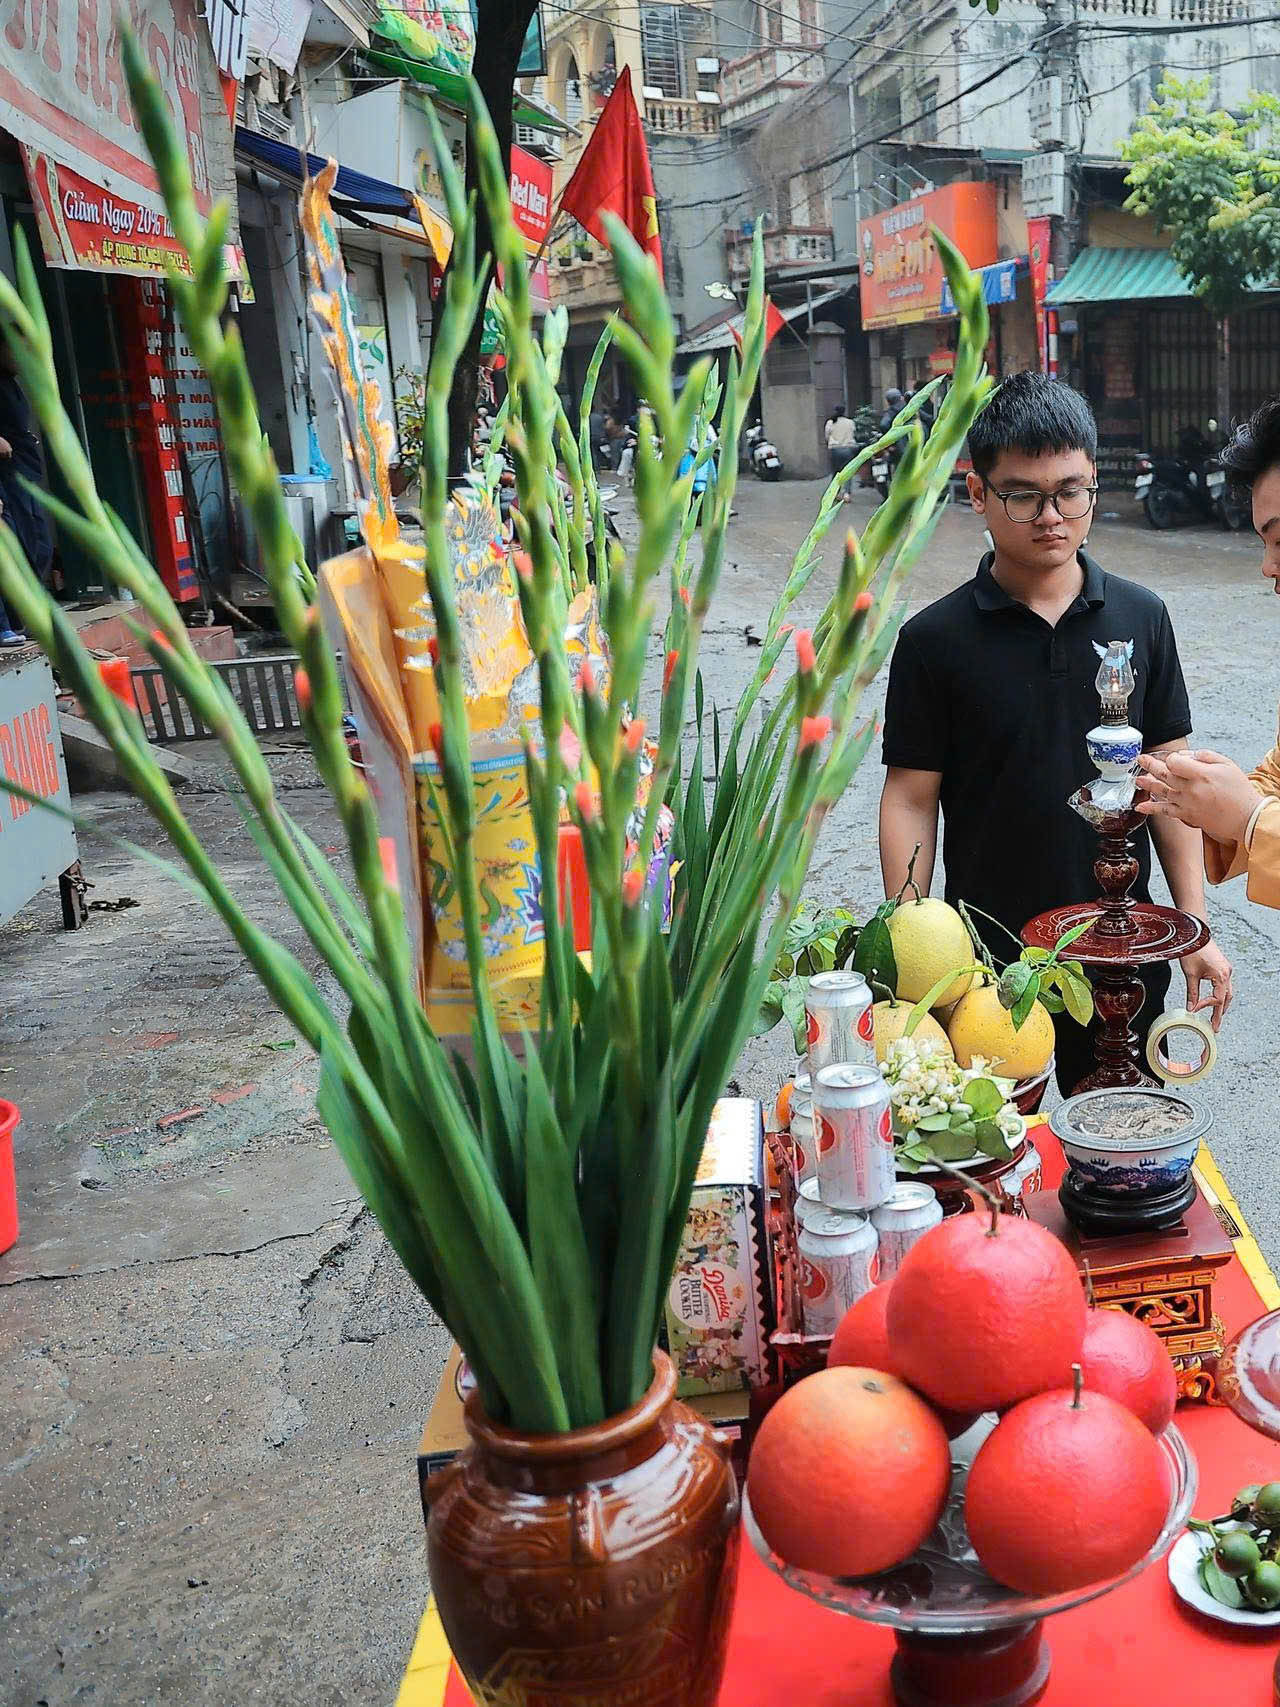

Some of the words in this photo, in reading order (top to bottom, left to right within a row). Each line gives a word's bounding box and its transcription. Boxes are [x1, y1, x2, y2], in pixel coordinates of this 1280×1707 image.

[63, 190, 100, 225] Giảm
[102, 198, 135, 235] Ngay
[137, 206, 161, 236] 20%
[679, 1276, 692, 1320] COOKIES
[691, 1276, 702, 1316] BUTTER
[701, 1266, 730, 1323] Danisa
